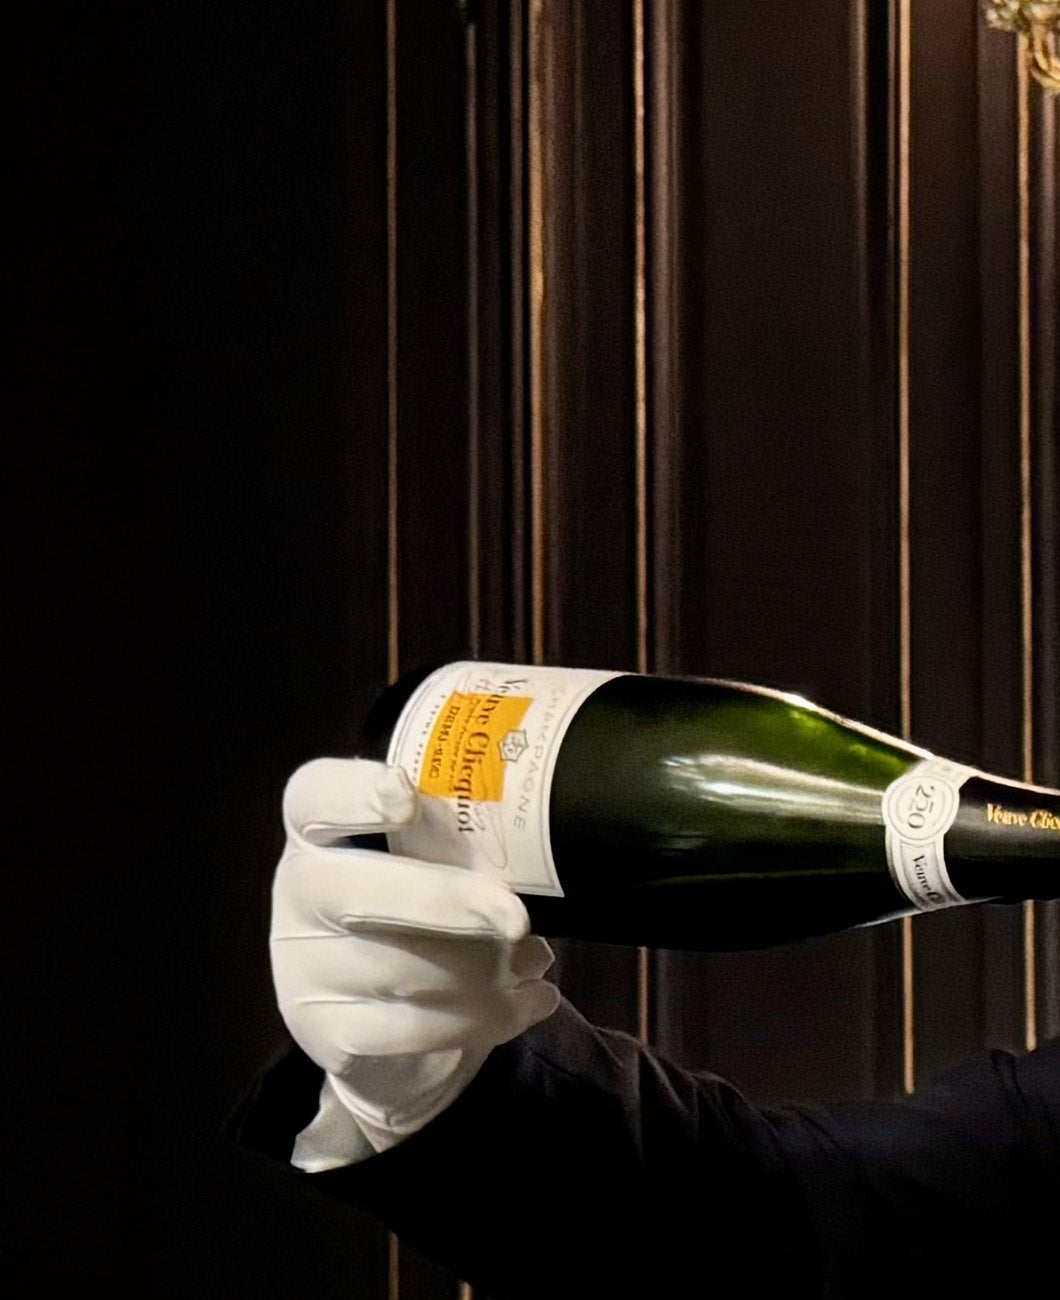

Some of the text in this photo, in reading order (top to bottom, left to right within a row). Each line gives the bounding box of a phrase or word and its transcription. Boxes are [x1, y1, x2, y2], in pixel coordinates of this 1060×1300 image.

[477, 679, 530, 726] Veuve
[456, 731, 491, 833] Clicquot
[513, 687, 567, 831] CHAMPAGNE
[986, 803, 1027, 826] Veuve
[912, 854, 932, 892] Veuve
